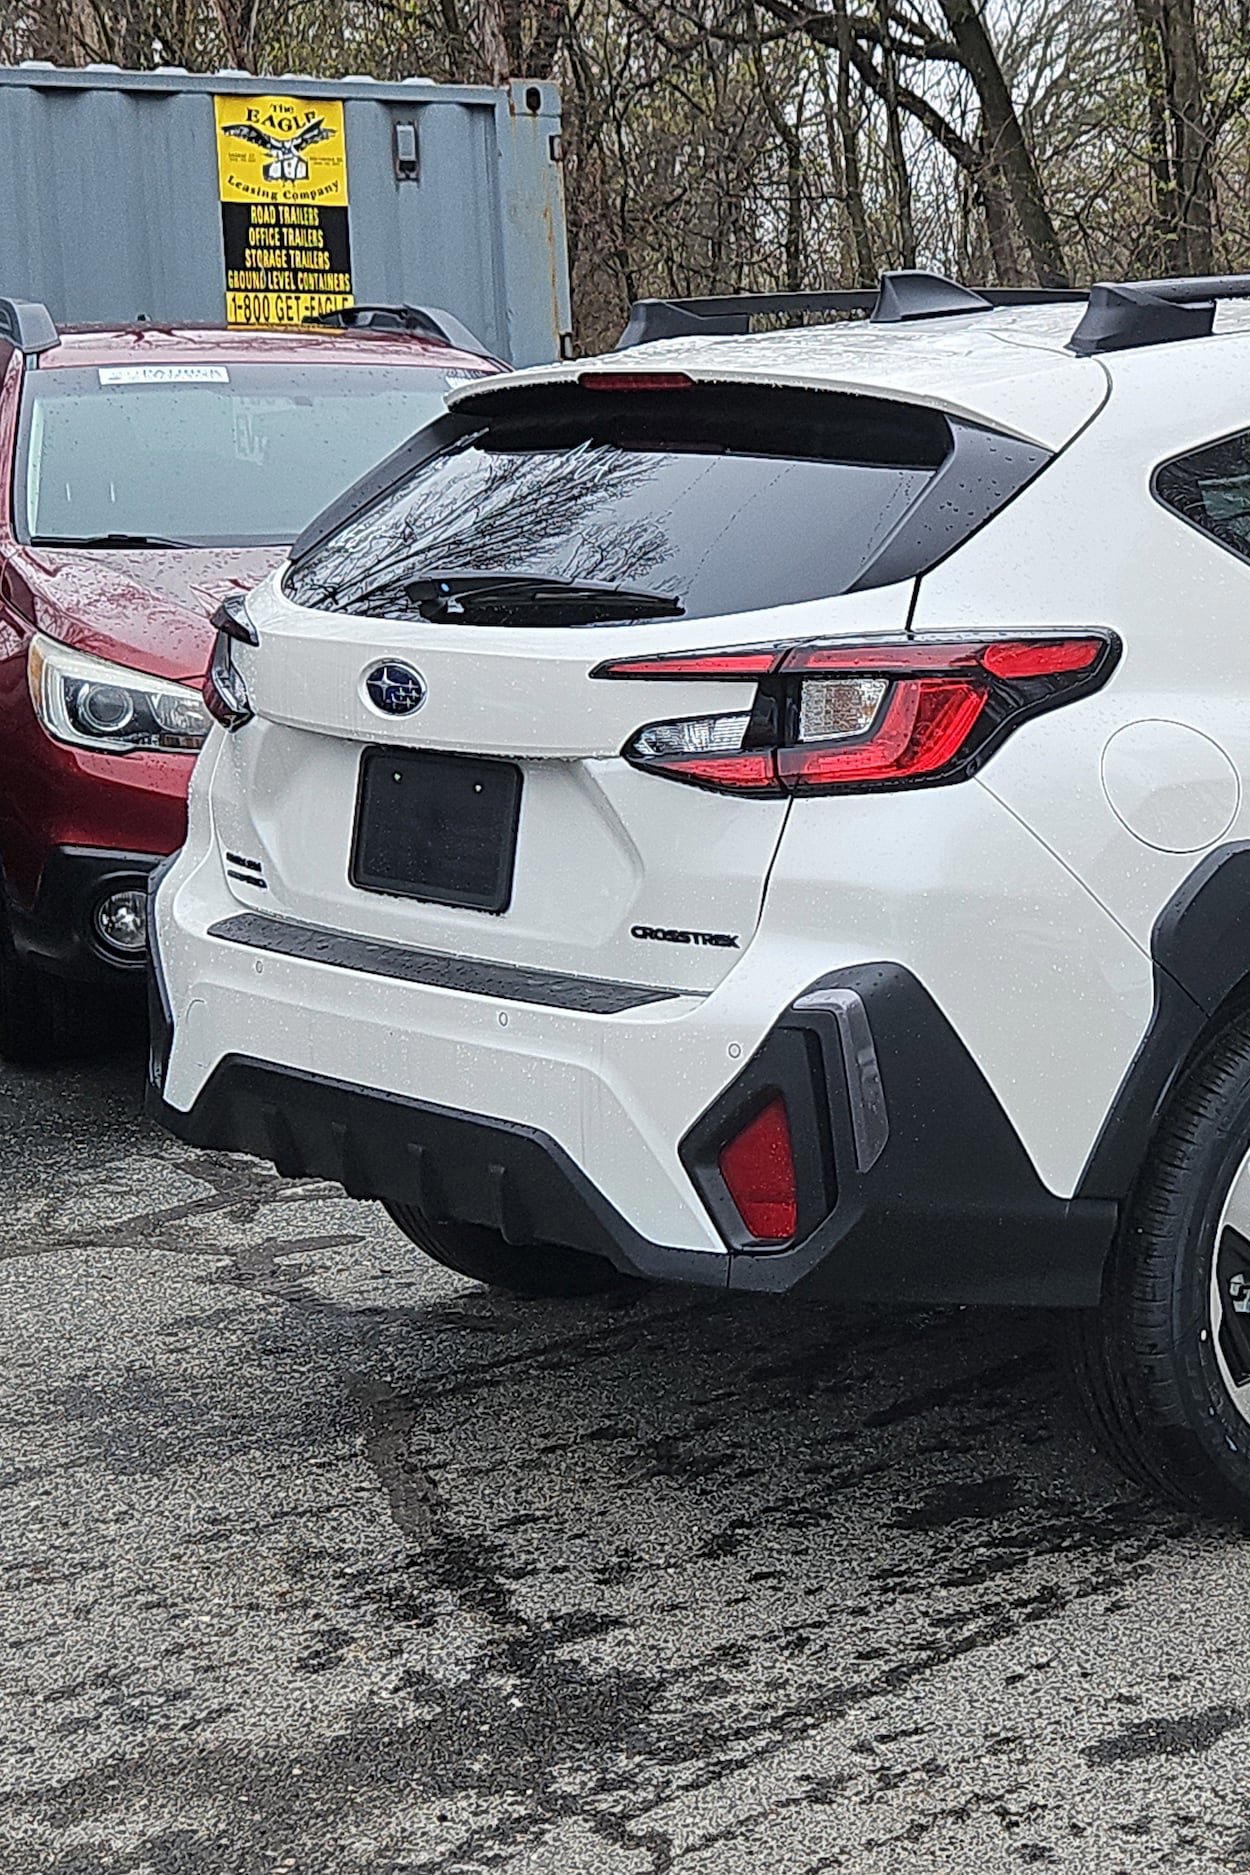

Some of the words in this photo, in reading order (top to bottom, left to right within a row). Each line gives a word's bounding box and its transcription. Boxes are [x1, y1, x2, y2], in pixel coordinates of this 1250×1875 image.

[246, 107, 317, 132] EAGLE
[271, 104, 294, 114] The
[227, 175, 278, 200] Leasing
[283, 180, 340, 201] Company
[251, 205, 276, 225] ROAD
[278, 206, 319, 226] TRAILERS
[248, 227, 280, 246] OFFICE
[282, 228, 324, 248] TRAILERS
[244, 248, 287, 268] STORAGE
[289, 249, 330, 270] TRAILERS
[227, 269, 266, 289] GROUND
[268, 271, 296, 290] LEVEL
[297, 272, 351, 291] CONTAINERS
[231, 294, 270, 323] 1-800
[630, 925, 740, 949] CROSSTREK
